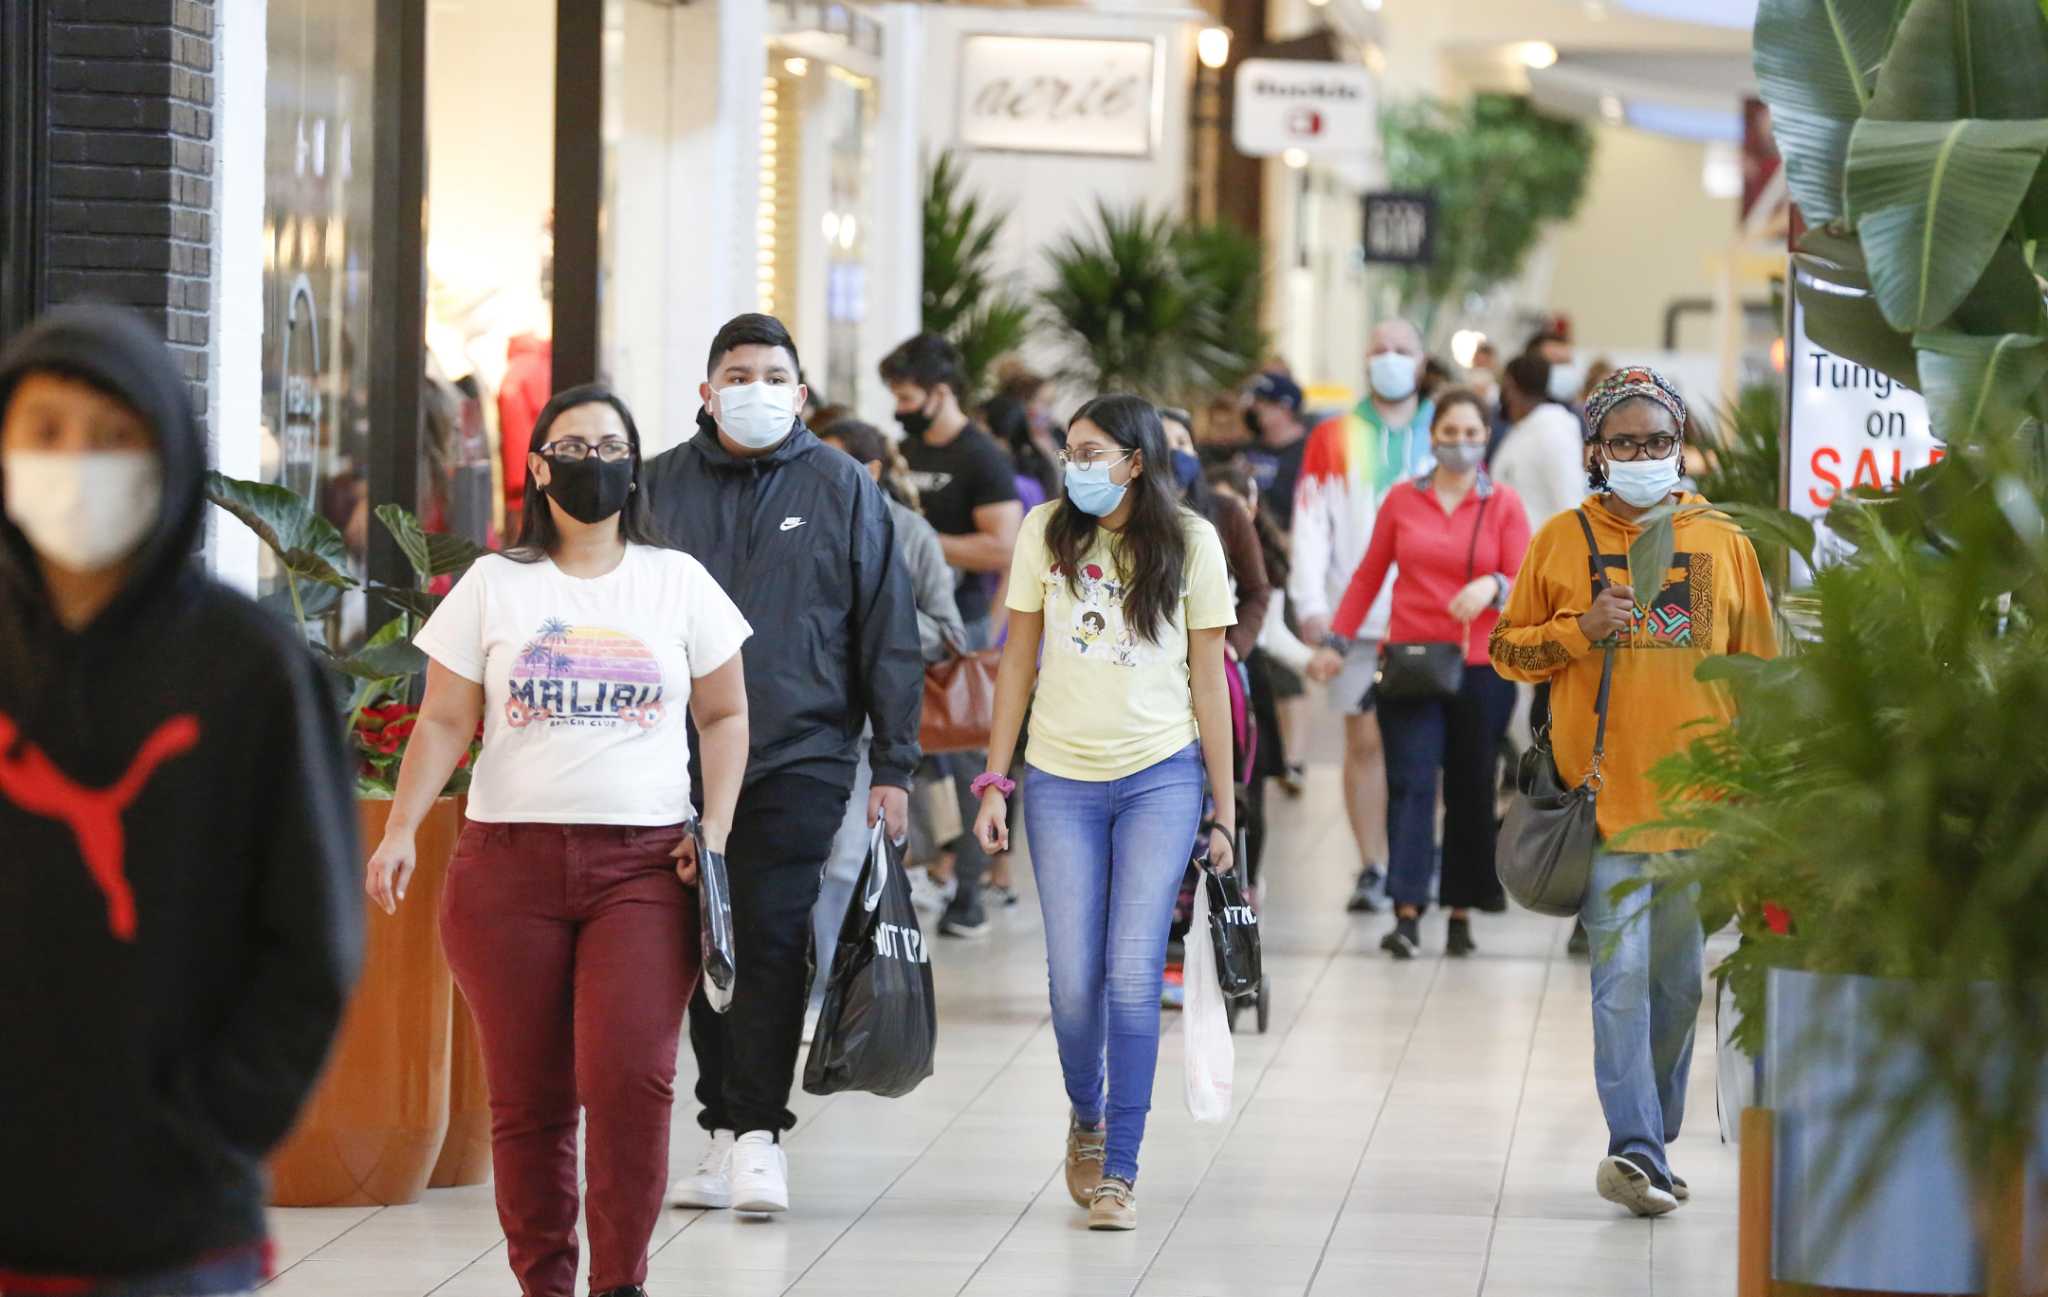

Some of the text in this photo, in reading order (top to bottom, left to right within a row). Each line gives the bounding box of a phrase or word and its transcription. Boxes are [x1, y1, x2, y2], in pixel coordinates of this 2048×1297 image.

[972, 58, 1140, 120] aerie
[1809, 352, 1910, 398] Tung
[1866, 410, 1906, 438] on
[509, 679, 663, 713] MALIBU
